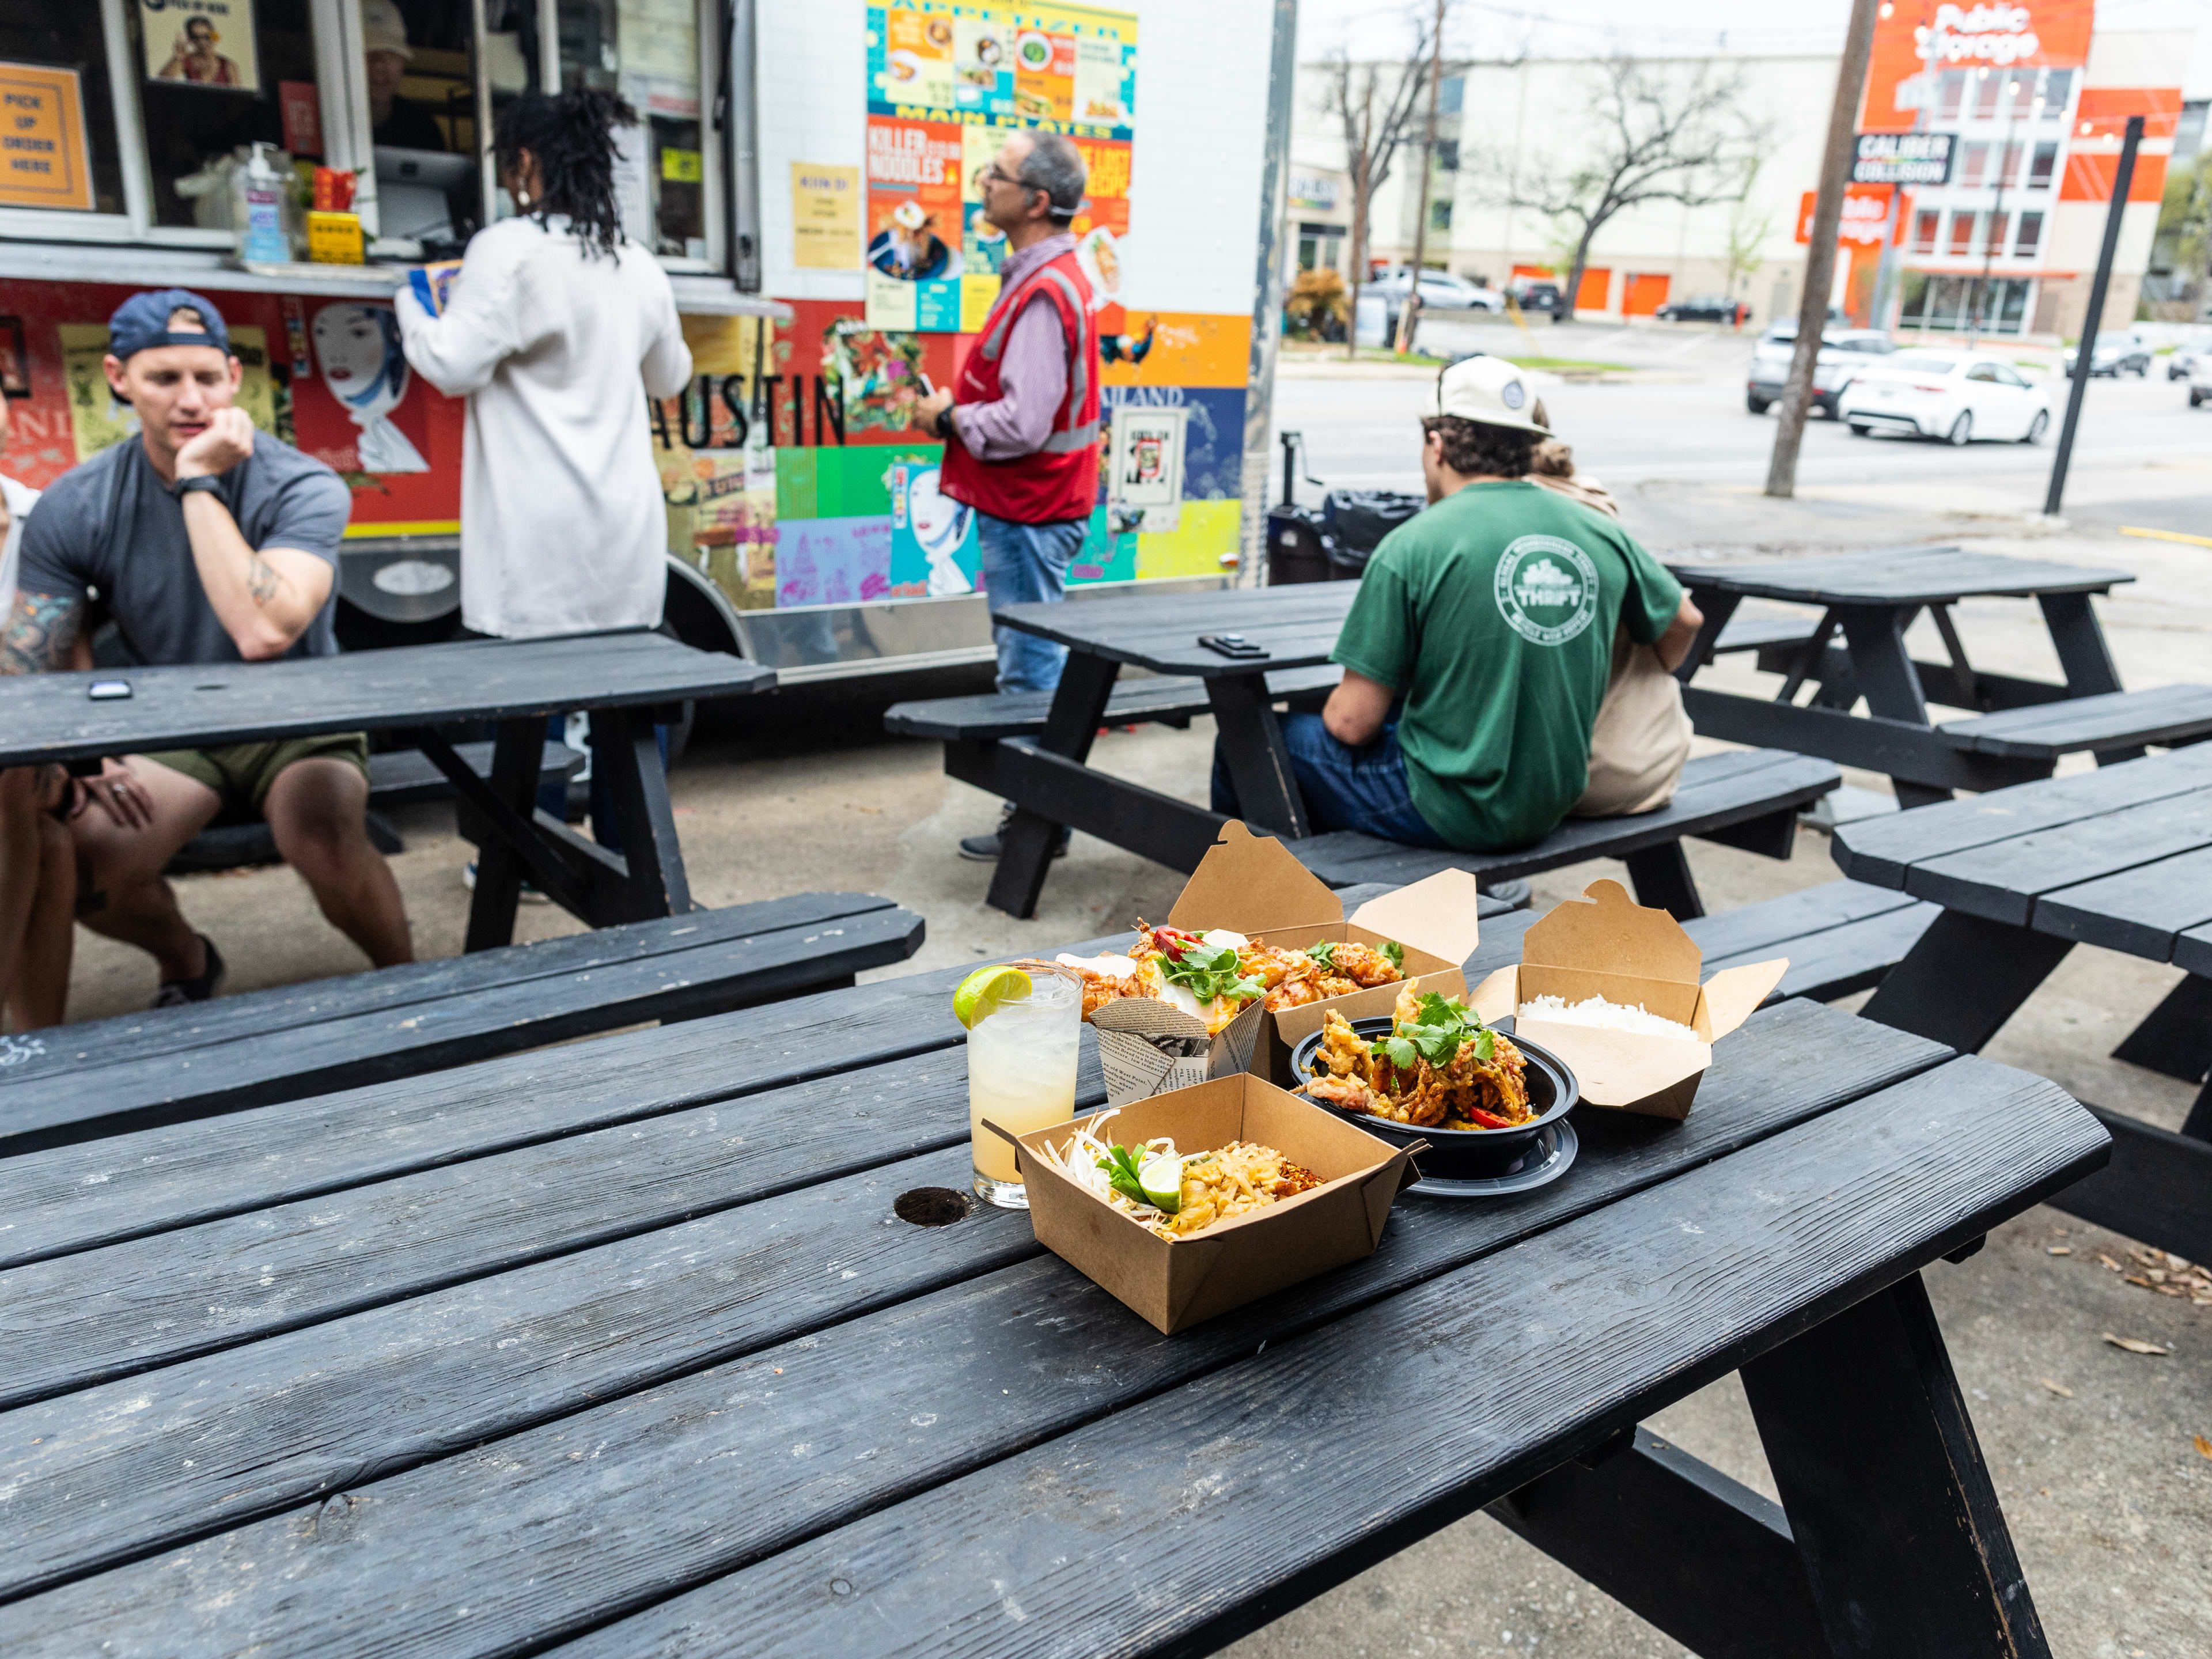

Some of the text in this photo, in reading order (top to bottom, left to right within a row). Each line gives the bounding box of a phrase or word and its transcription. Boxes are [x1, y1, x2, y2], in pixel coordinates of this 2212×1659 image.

[1934, 3, 2031, 33] Public
[1915, 30, 2039, 65] Storage
[14, 116, 36, 129] UP
[896, 105, 1112, 138] MAIN PLATES
[2, 136, 55, 152] ORDER
[869, 126, 927, 155] KILLER
[1858, 135, 1950, 158] CALIBER
[10, 158, 51, 174] HERE
[869, 154, 945, 184] NOODLES
[1854, 161, 1947, 183] COLLISION
[1841, 196, 1885, 220] blic
[1103, 1035, 1127, 1049] production
[1127, 1046, 1145, 1056] process
[1118, 1032, 1132, 1041] brown
[1120, 1048, 1135, 1056] Bread
[1124, 1040, 1139, 1050] baking
[1139, 1047, 1159, 1058] process;
[1159, 1055, 1172, 1063] many
[1119, 1070, 1131, 1078] West
[1119, 1081, 1134, 1090] wheat
